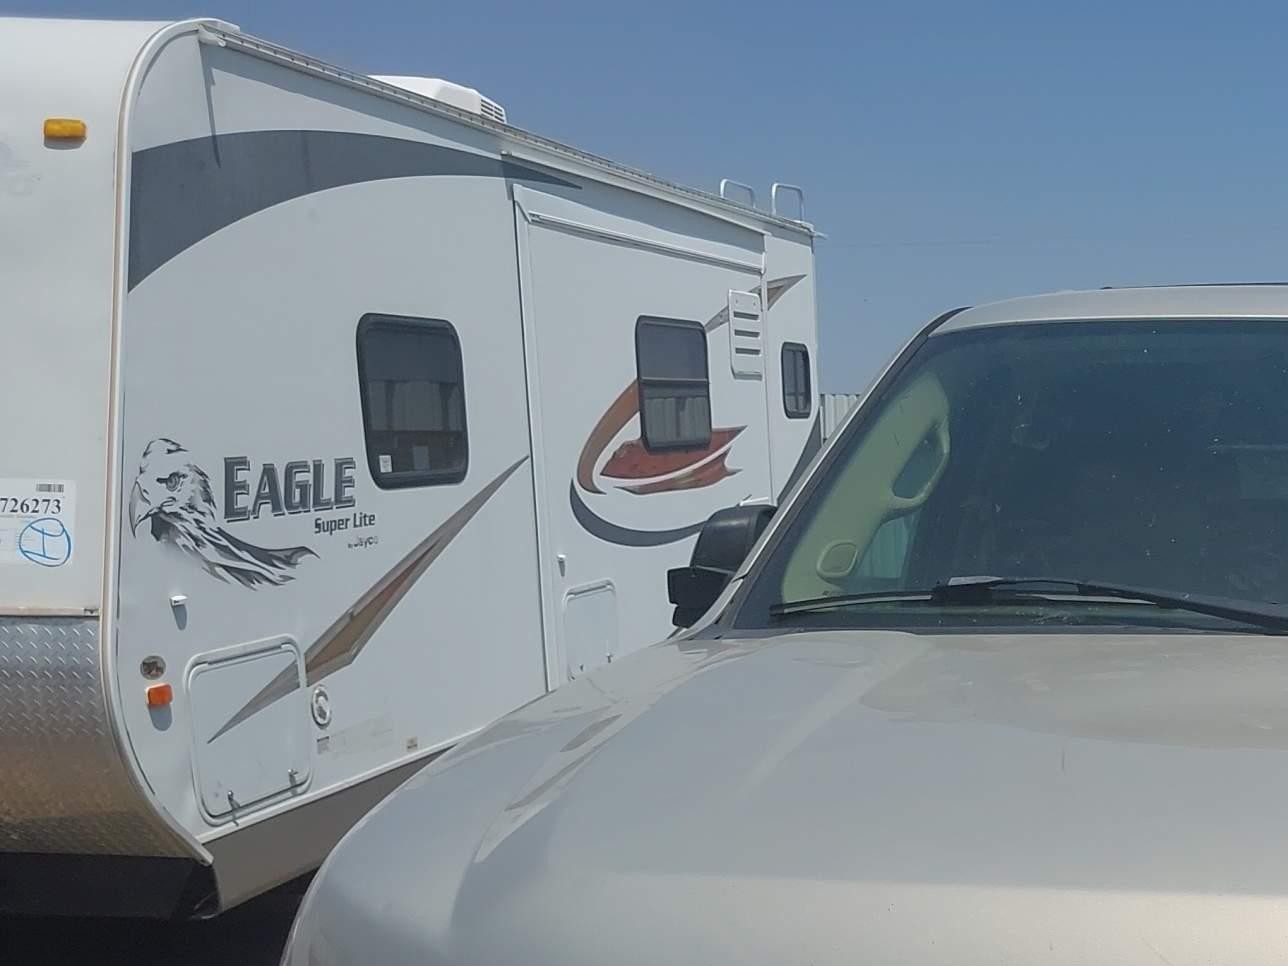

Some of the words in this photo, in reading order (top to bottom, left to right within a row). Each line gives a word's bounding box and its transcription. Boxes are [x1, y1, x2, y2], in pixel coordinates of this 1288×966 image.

[224, 456, 356, 523] EAGLE
[314, 518, 350, 536] Super
[353, 512, 376, 528] Lite
